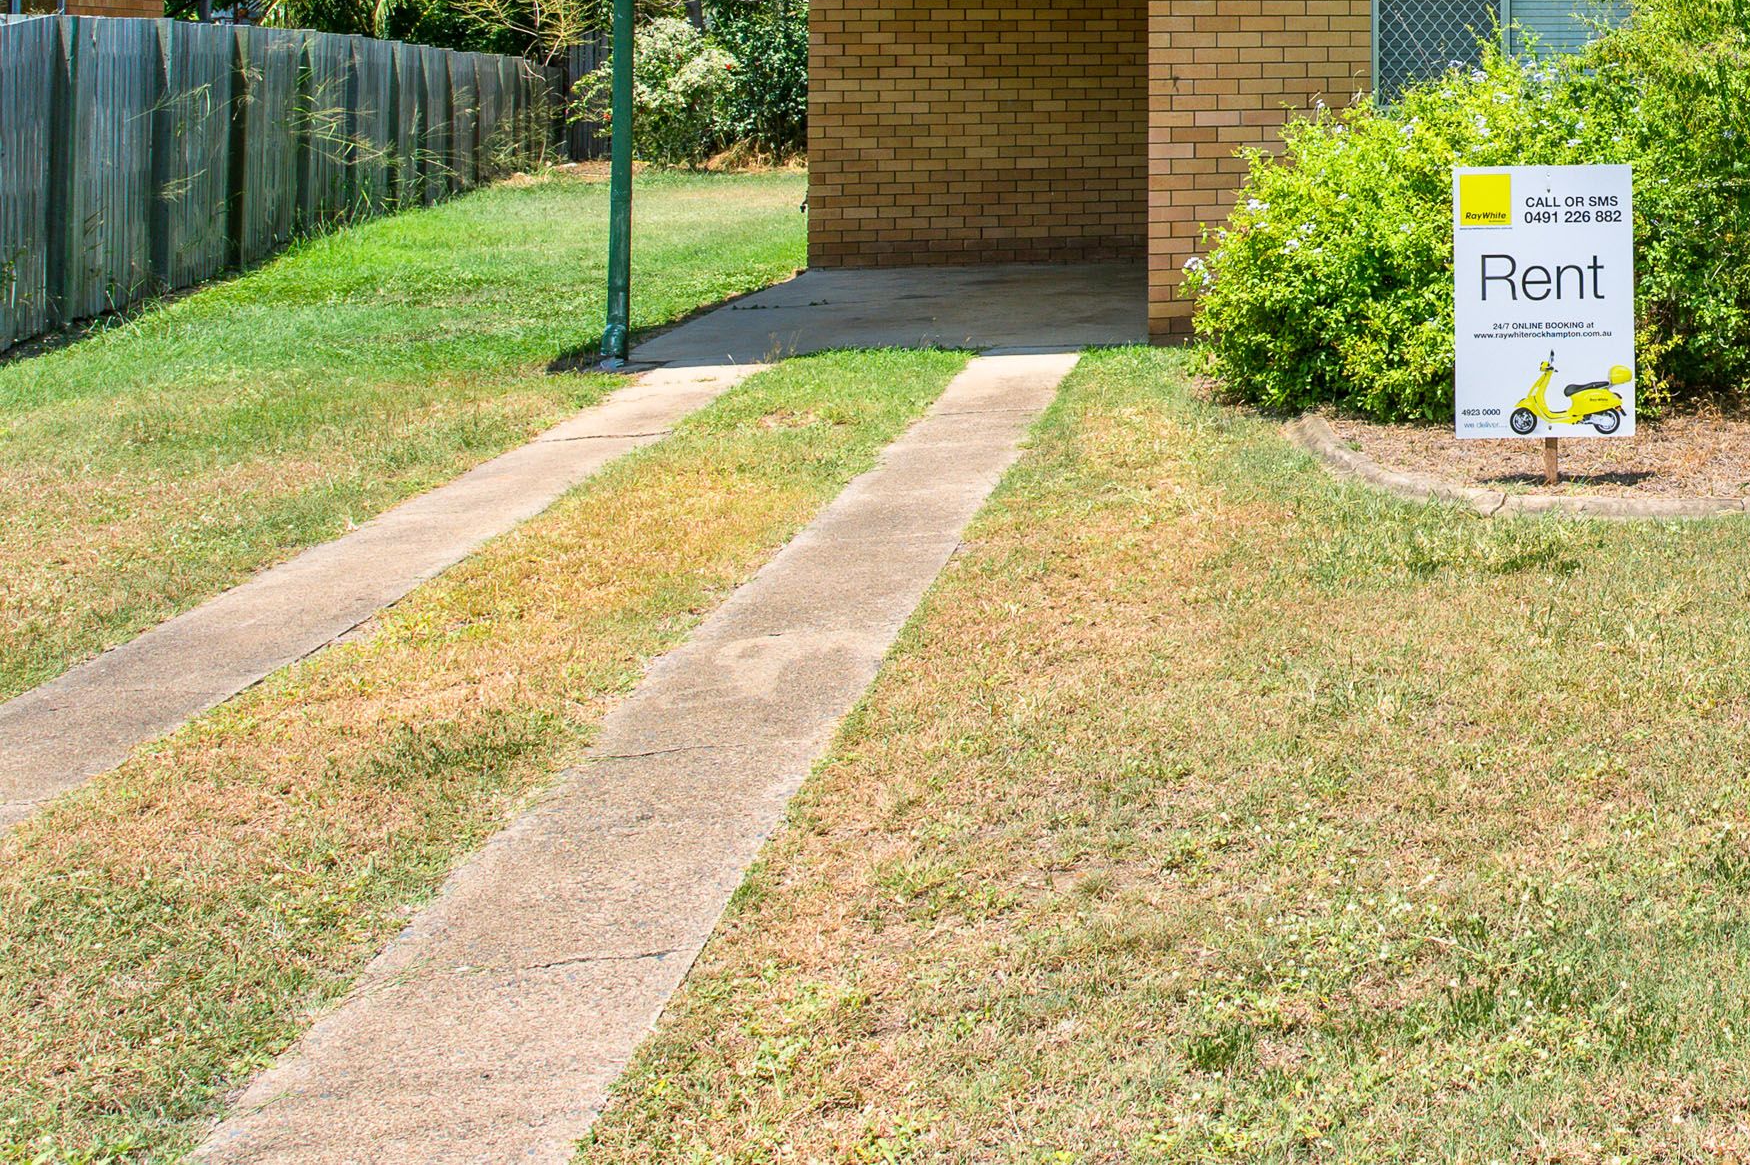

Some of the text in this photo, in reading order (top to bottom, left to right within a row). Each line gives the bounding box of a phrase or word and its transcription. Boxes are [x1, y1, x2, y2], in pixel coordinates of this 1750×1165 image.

[1525, 196, 1618, 208] CALL OR SMS
[1524, 210, 1622, 224] 0491 226 882
[1481, 254, 1605, 301] Rent
[1511, 322, 1543, 330] ONLINE
[1474, 331, 1612, 339] www.raywhiterockhampton.com.au
